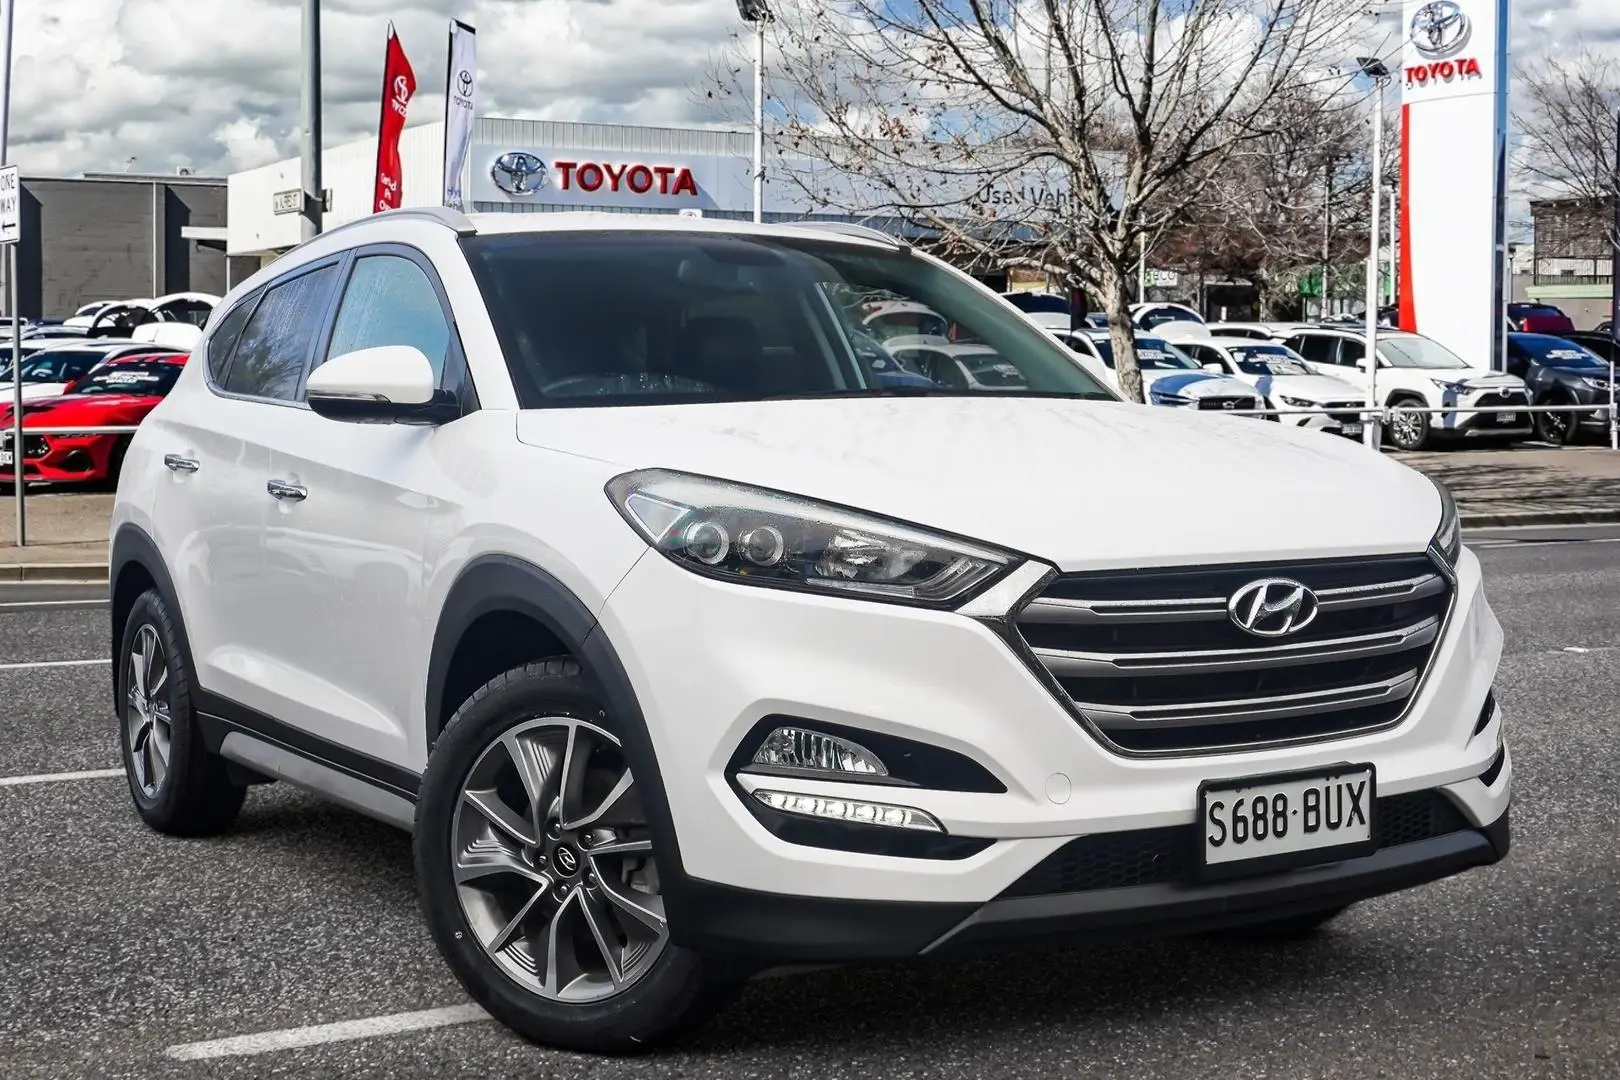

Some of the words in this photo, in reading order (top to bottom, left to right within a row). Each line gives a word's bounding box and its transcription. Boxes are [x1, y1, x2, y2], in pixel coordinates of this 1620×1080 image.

[1404, 58, 1481, 83] TOYOTA
[1, 173, 16, 192] ONE
[554, 161, 699, 196] TOYOTA
[0, 197, 16, 214] WAY
